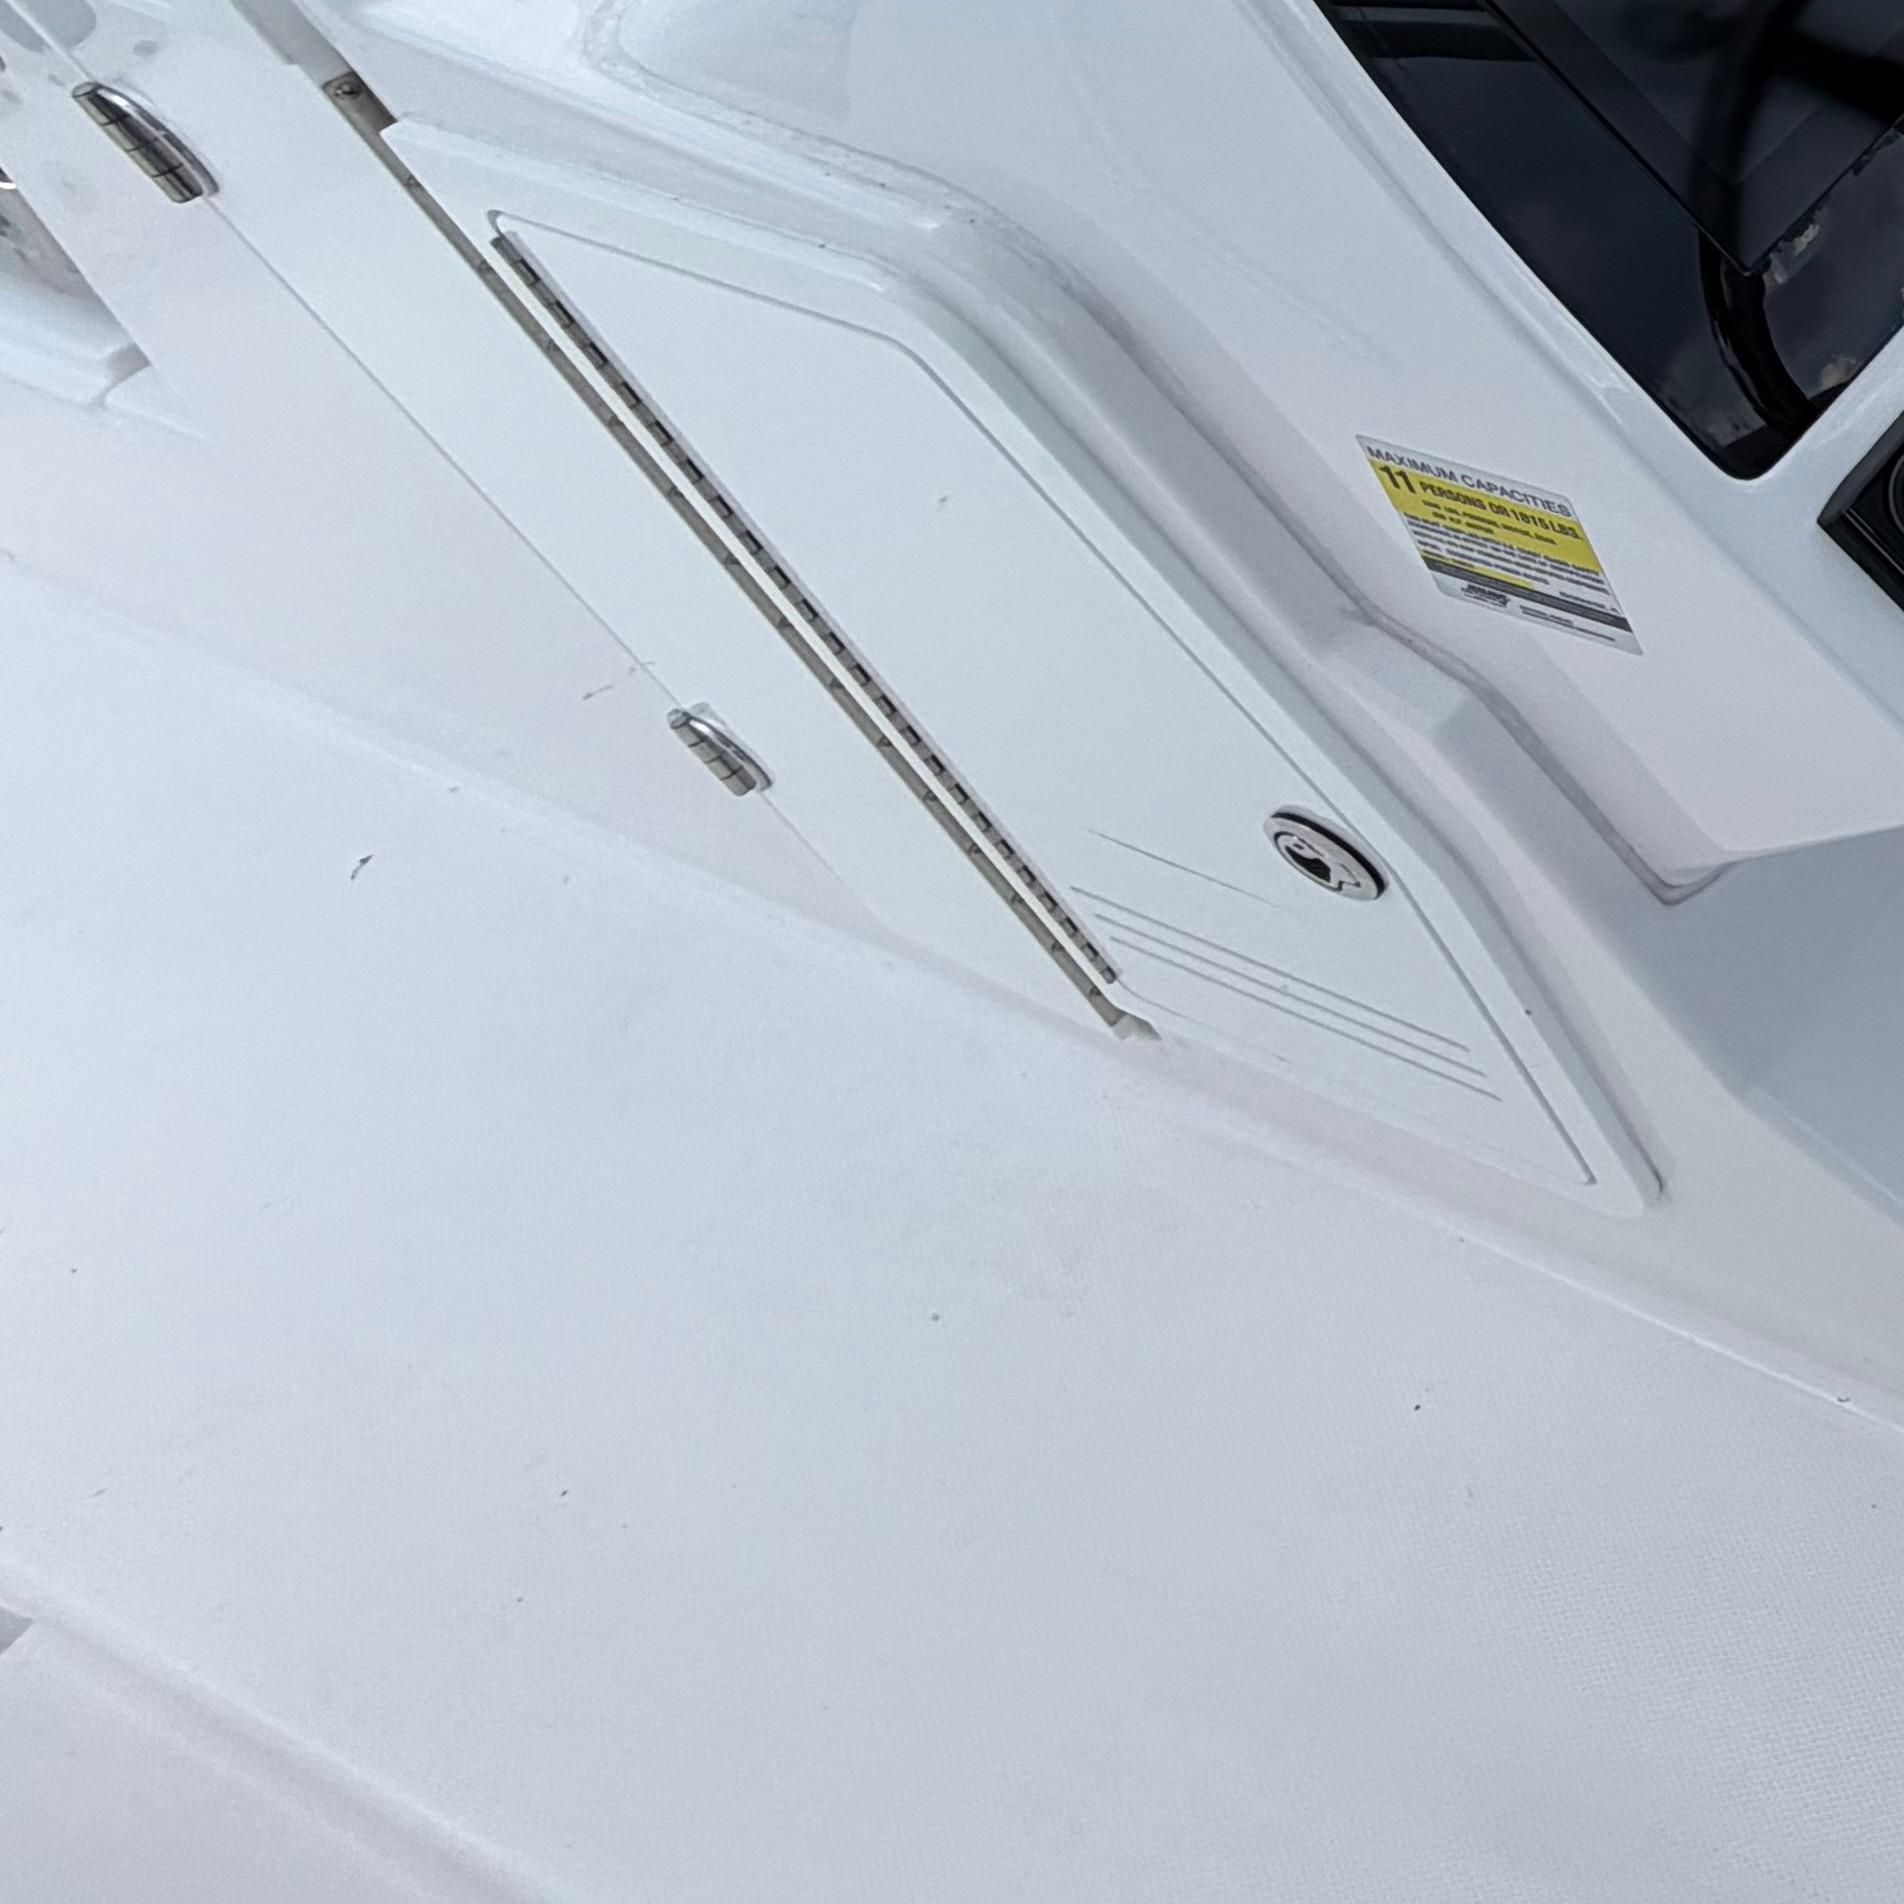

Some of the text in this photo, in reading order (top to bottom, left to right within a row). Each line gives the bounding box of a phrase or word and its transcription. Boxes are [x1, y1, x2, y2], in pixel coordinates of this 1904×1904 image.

[1367, 445, 1573, 518] MAXIMUM CAPACITIES
[1378, 464, 1417, 495] 11
[1418, 482, 1489, 511] PERSONS
